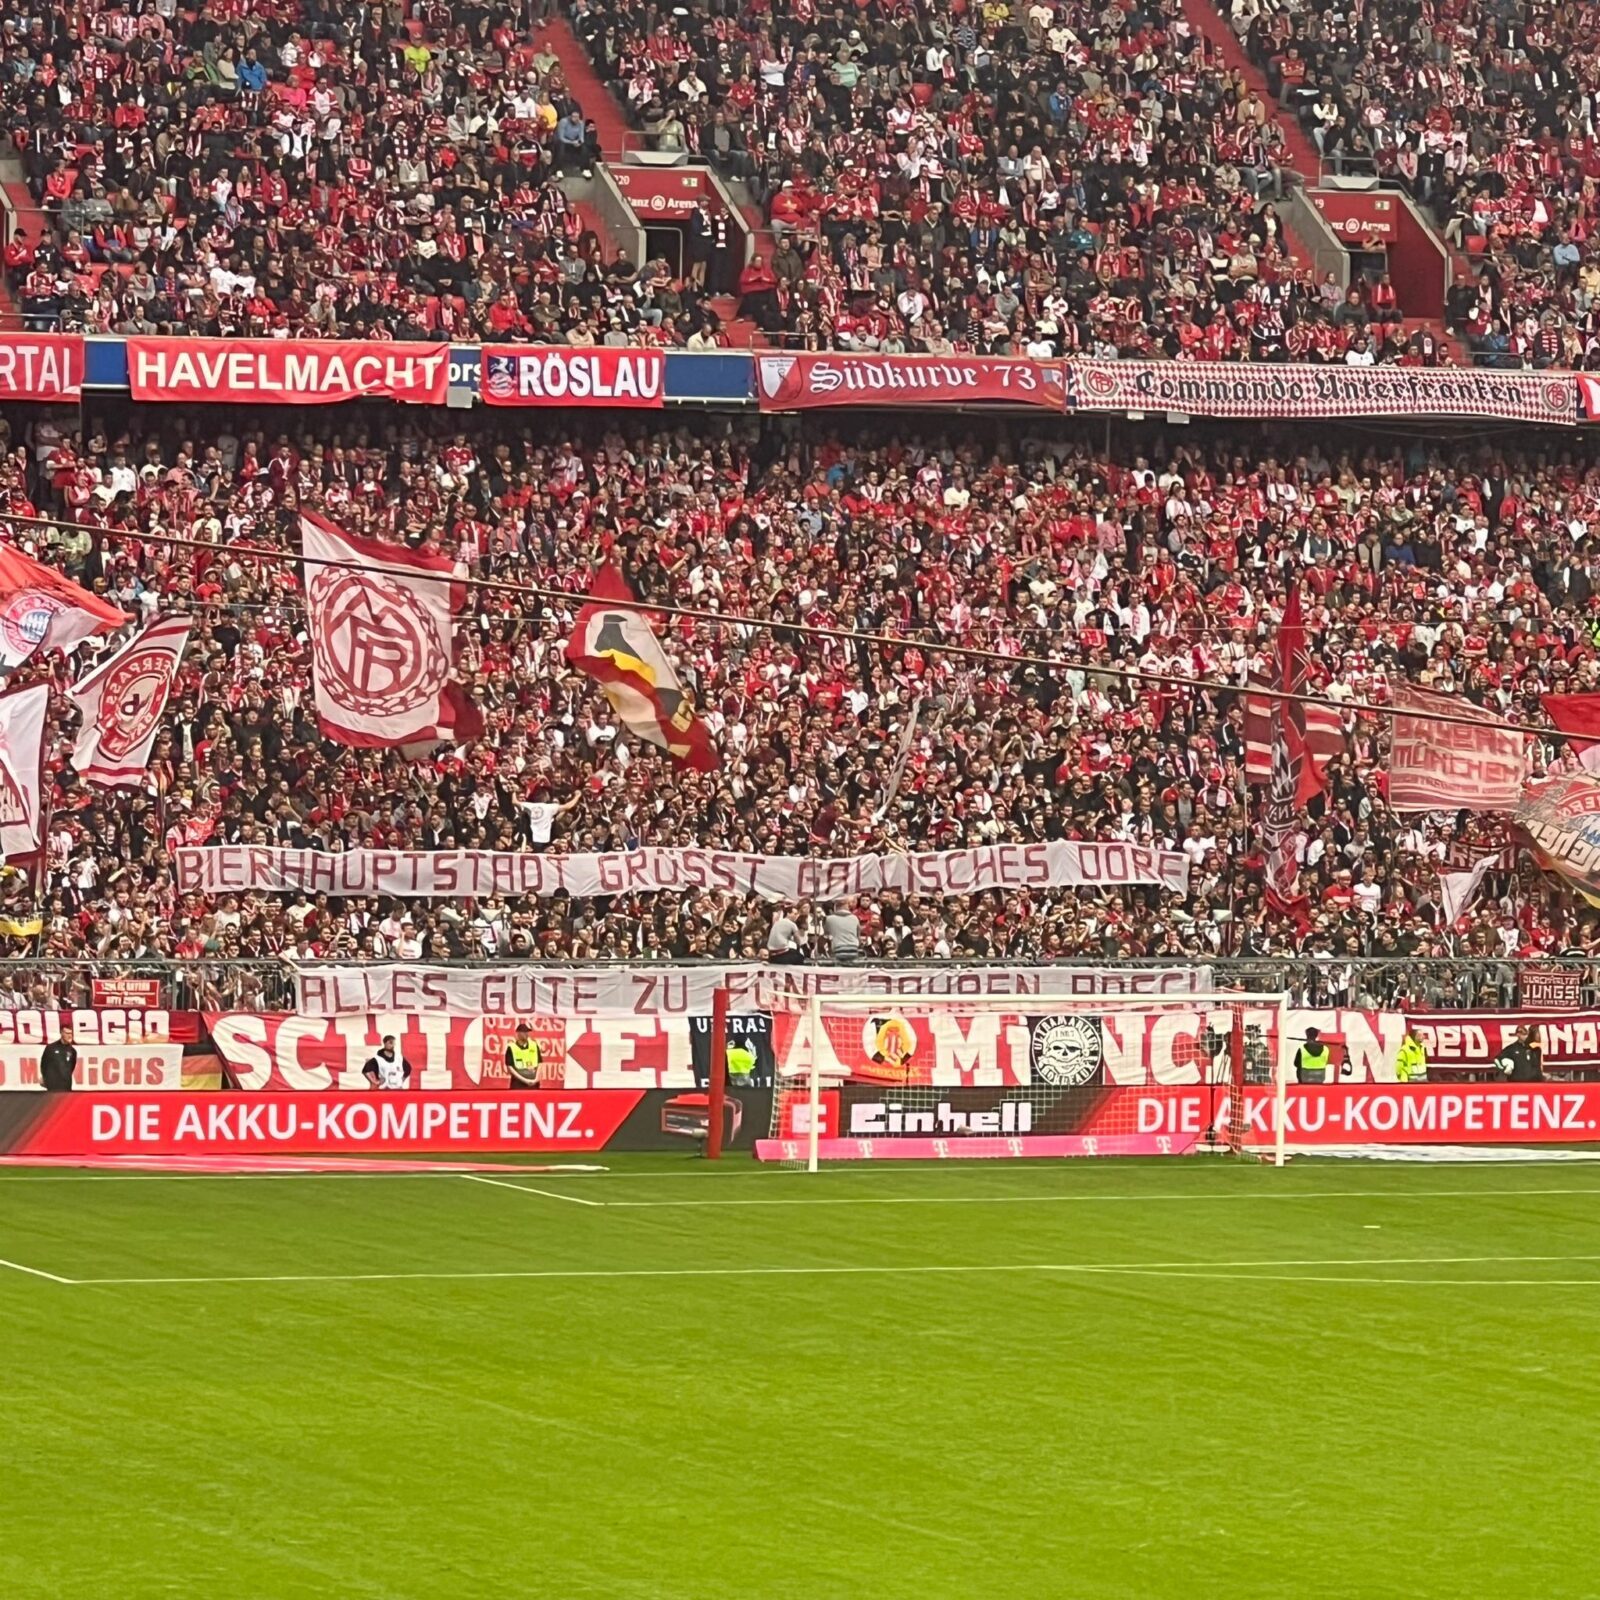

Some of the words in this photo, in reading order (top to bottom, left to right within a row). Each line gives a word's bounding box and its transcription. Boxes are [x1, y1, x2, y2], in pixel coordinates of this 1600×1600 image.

[137, 351, 443, 392] HAVELMACHT
[519, 353, 660, 398] RÖSLAU
[808, 360, 979, 394] Südkurve
[1135, 370, 1304, 400] Commando
[1315, 371, 1523, 407] Unterfranken
[180, 846, 570, 892] BIERHAUPTSTADT
[598, 848, 766, 892] GRÜSST
[797, 846, 1052, 897] GALLISCHES
[1079, 844, 1184, 883] DORF
[300, 970, 448, 1013] ALLES
[482, 974, 598, 1014] GUTE
[631, 974, 688, 1014] ZU
[1523, 985, 1580, 1000] JUNGS!
[20, 1057, 165, 1085] MNiCHS
[91, 1104, 161, 1141] DIE
[173, 1102, 595, 1141] AKKU-KOMPETENZ.
[850, 1102, 1032, 1133] Einhell
[1137, 1098, 1201, 1133] DIE
[1213, 1094, 1597, 1133] AKKU-KOMPETENZ.
